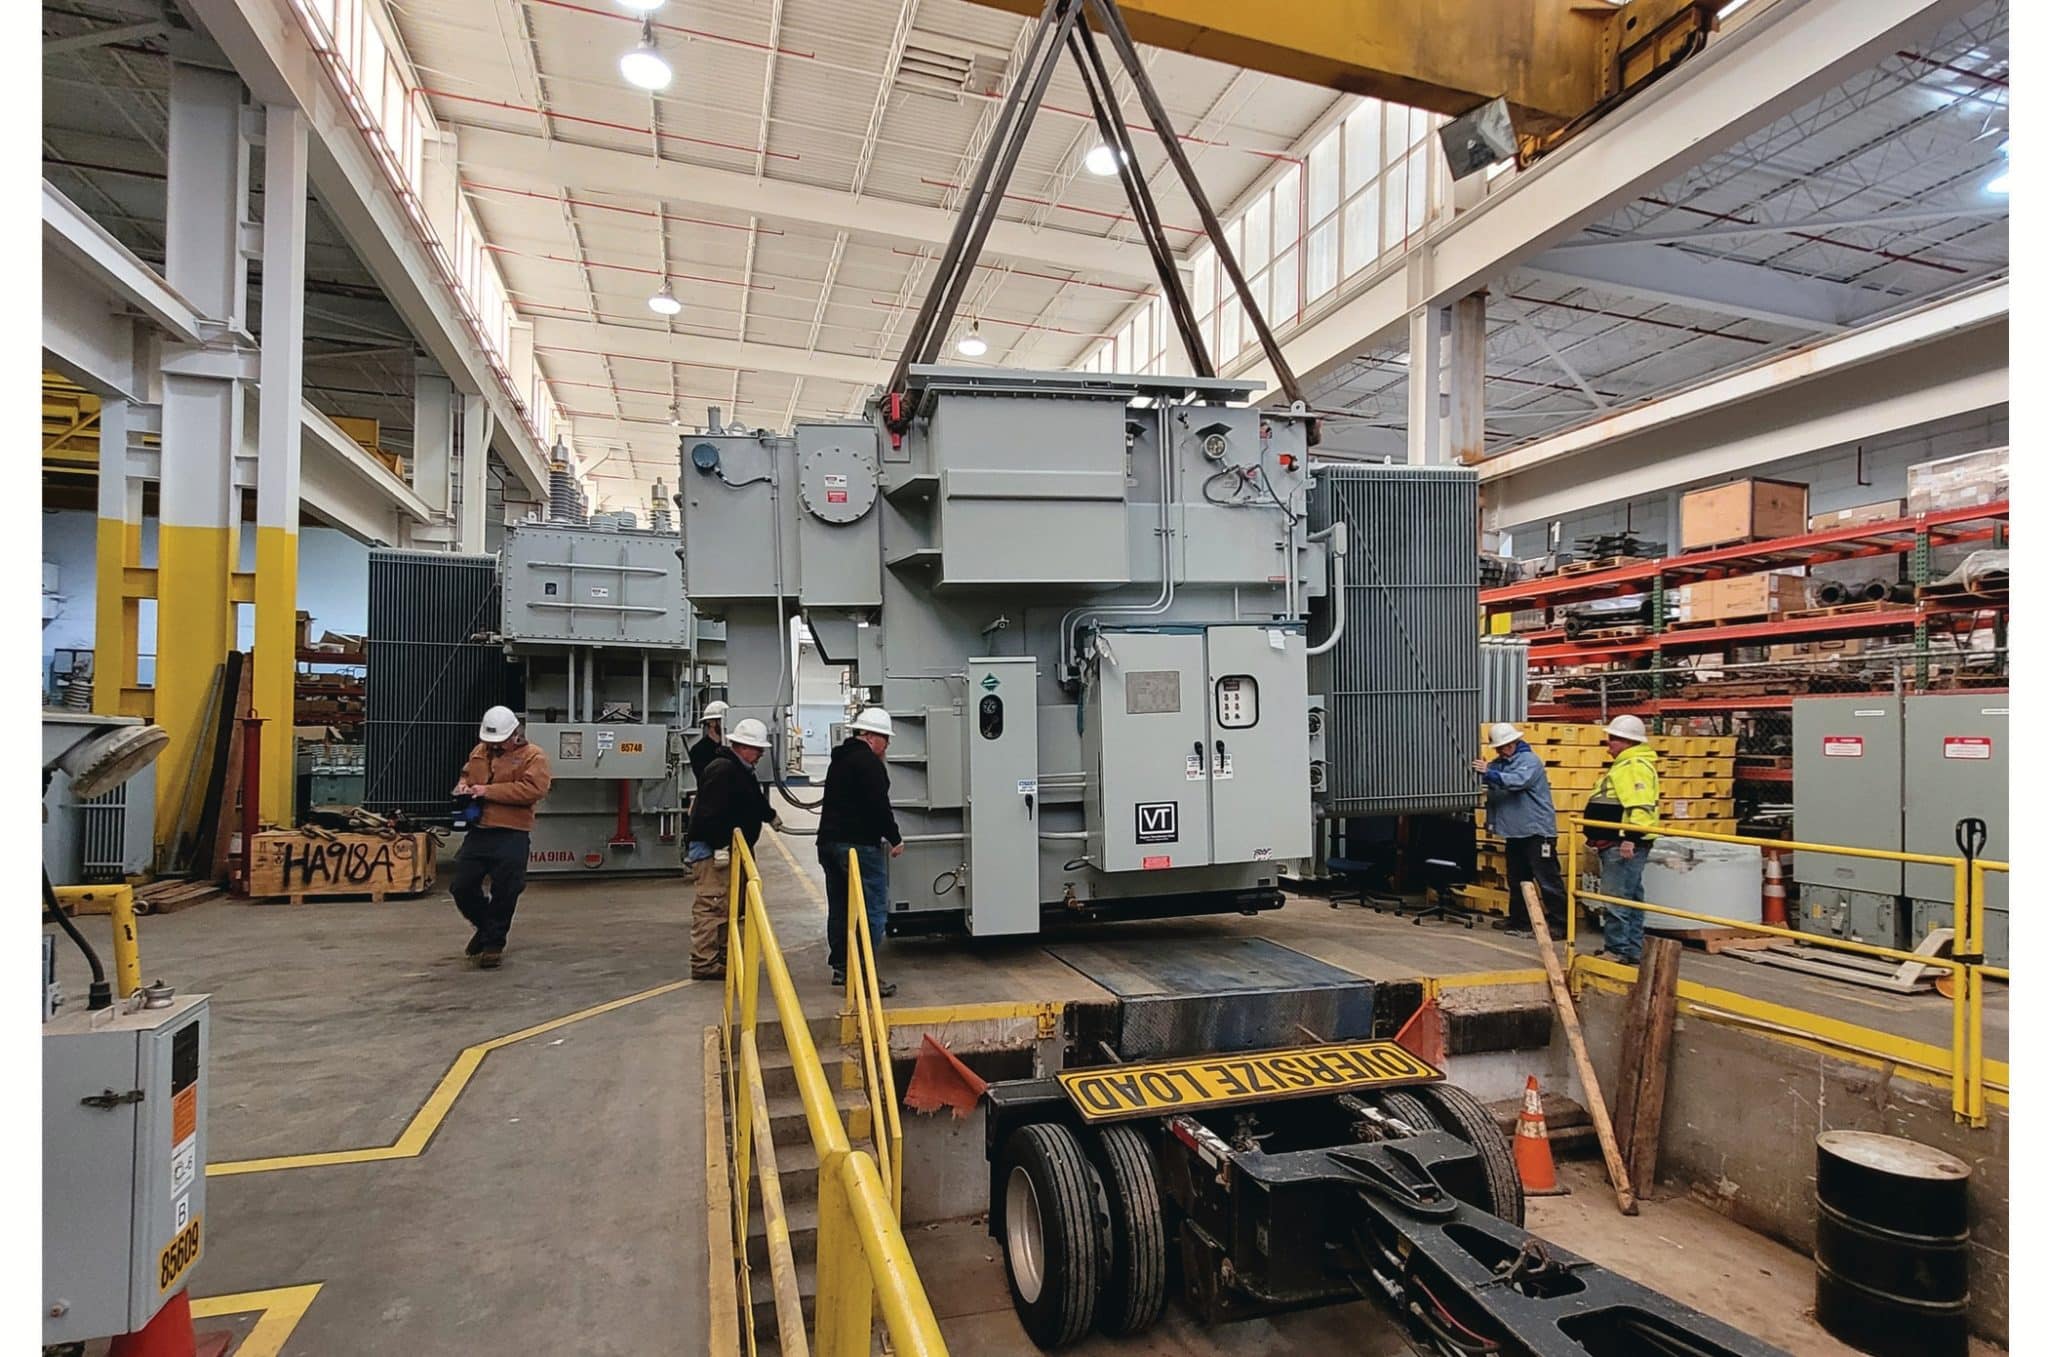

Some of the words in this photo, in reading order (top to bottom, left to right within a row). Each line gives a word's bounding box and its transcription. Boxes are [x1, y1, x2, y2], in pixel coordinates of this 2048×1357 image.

[1143, 808, 1171, 830] VT
[281, 841, 395, 888] HA918A
[1079, 1070, 1206, 1109] LOAD
[1206, 1048, 1419, 1094] OVERSIZE
[178, 1202, 186, 1227] B
[161, 1221, 199, 1289] 85609
